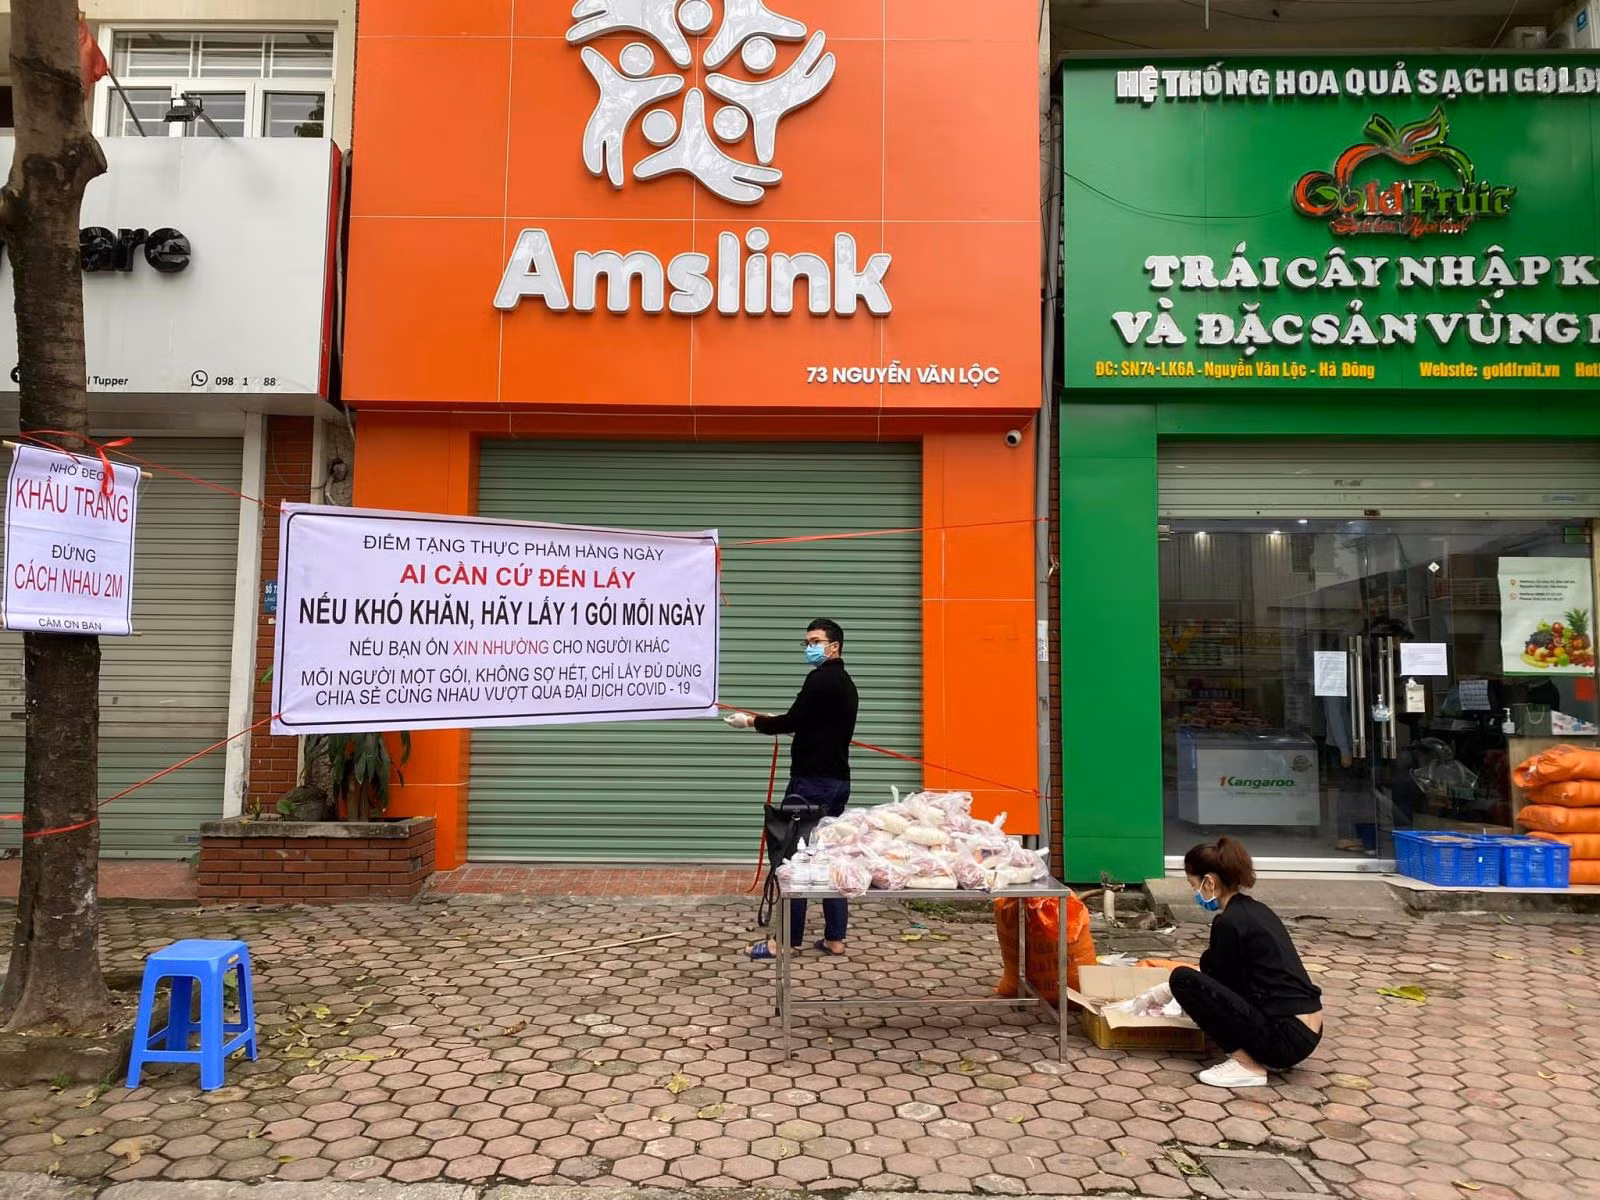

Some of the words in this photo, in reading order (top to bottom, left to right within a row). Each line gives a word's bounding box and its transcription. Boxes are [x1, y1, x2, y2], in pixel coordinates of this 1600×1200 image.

[1116, 65, 1159, 102] HỆ
[1162, 61, 1270, 97] THỐNG
[1276, 70, 1340, 95] HOA
[1345, 61, 1412, 96] QUẢ
[1418, 68, 1508, 98] SẠCH
[1514, 66, 1600, 94] GOLD
[1412, 179, 1516, 216] Fruit
[80, 227, 191, 273] are
[493, 226, 893, 318] Amslink
[1145, 240, 1280, 288] TRÁI
[1285, 246, 1389, 288] CÂY
[1400, 245, 1551, 298] NHẬP
[1560, 256, 1600, 286] K
[1112, 297, 1187, 344] VÀ
[1198, 302, 1303, 356] ĐẶC
[1311, 299, 1417, 345] SẢN
[1426, 299, 1581, 344] VÙNG
[93, 376, 129, 387] Tupper
[215, 376, 234, 386] 098
[263, 377, 276, 387] 88
[806, 367, 828, 383] 73
[832, 360, 911, 384] NGUYỄN
[916, 364, 955, 384] VĂN
[959, 363, 1000, 388] LỘC
[1096, 361, 1118, 377] ĐC:
[1204, 358, 1253, 379] Nguyễn
[1255, 361, 1279, 377] Văn
[1282, 361, 1307, 380] Lộc
[1319, 361, 1337, 377] Hà
[1342, 361, 1375, 380] Đông
[1420, 362, 1477, 377] Website:
[1483, 362, 1560, 380] goldfruit.vn
[81, 467, 105, 481] ĐEO
[16, 475, 68, 513] KHẨU
[74, 486, 128, 523] TRANG
[52, 543, 96, 563] ĐỨNG
[416, 537, 465, 554] TẶNG
[470, 540, 519, 557] THỰC
[623, 546, 664, 561] NGÀY
[14, 559, 58, 592] CÁCH
[61, 568, 101, 596] NHAU
[104, 573, 122, 598] 2M
[400, 564, 425, 584] AI
[434, 561, 487, 586] CẦN
[496, 563, 533, 587] CỨ
[539, 565, 585, 588] ĐẾN
[594, 567, 636, 589] LẤY
[300, 592, 346, 624] NẾU
[355, 592, 403, 625] KHÓ
[410, 593, 474, 630] KHĂN,
[481, 594, 522, 625] HÃY
[528, 596, 565, 625] LẤY
[571, 602, 578, 625] 1
[585, 596, 617, 626] GÓI
[623, 597, 654, 626] MỖI
[659, 598, 705, 626] NGÀY
[349, 637, 383, 656] NẾU
[388, 640, 421, 659] BẠN
[453, 640, 478, 655] XIN
[482, 637, 549, 655] NHƯỜNG
[553, 640, 583, 654] CHO
[586, 636, 632, 654] NGƯỜI
[635, 636, 670, 654] KHÁC
[301, 667, 333, 686] MỖI
[338, 666, 395, 686] NGƯỜI
[400, 667, 436, 687] MỘT
[439, 665, 471, 685] GÓI,
[475, 665, 529, 684] KHÔNG
[533, 667, 555, 684] SỢ
[592, 663, 614, 680] CHỈ
[644, 662, 662, 679] ĐỦ
[666, 662, 701, 678] DÙNG
[316, 690, 355, 706] CHIA
[360, 686, 380, 705] SẺ
[386, 685, 432, 704] CÙNG
[437, 687, 479, 702] NHAU
[484, 686, 528, 703] VƯỢT
[531, 685, 561, 700] QUA
[565, 684, 587, 700] ĐẠI
[592, 683, 623, 700] DỊCH
[627, 682, 666, 696] COVID
[677, 681, 690, 694] 19
